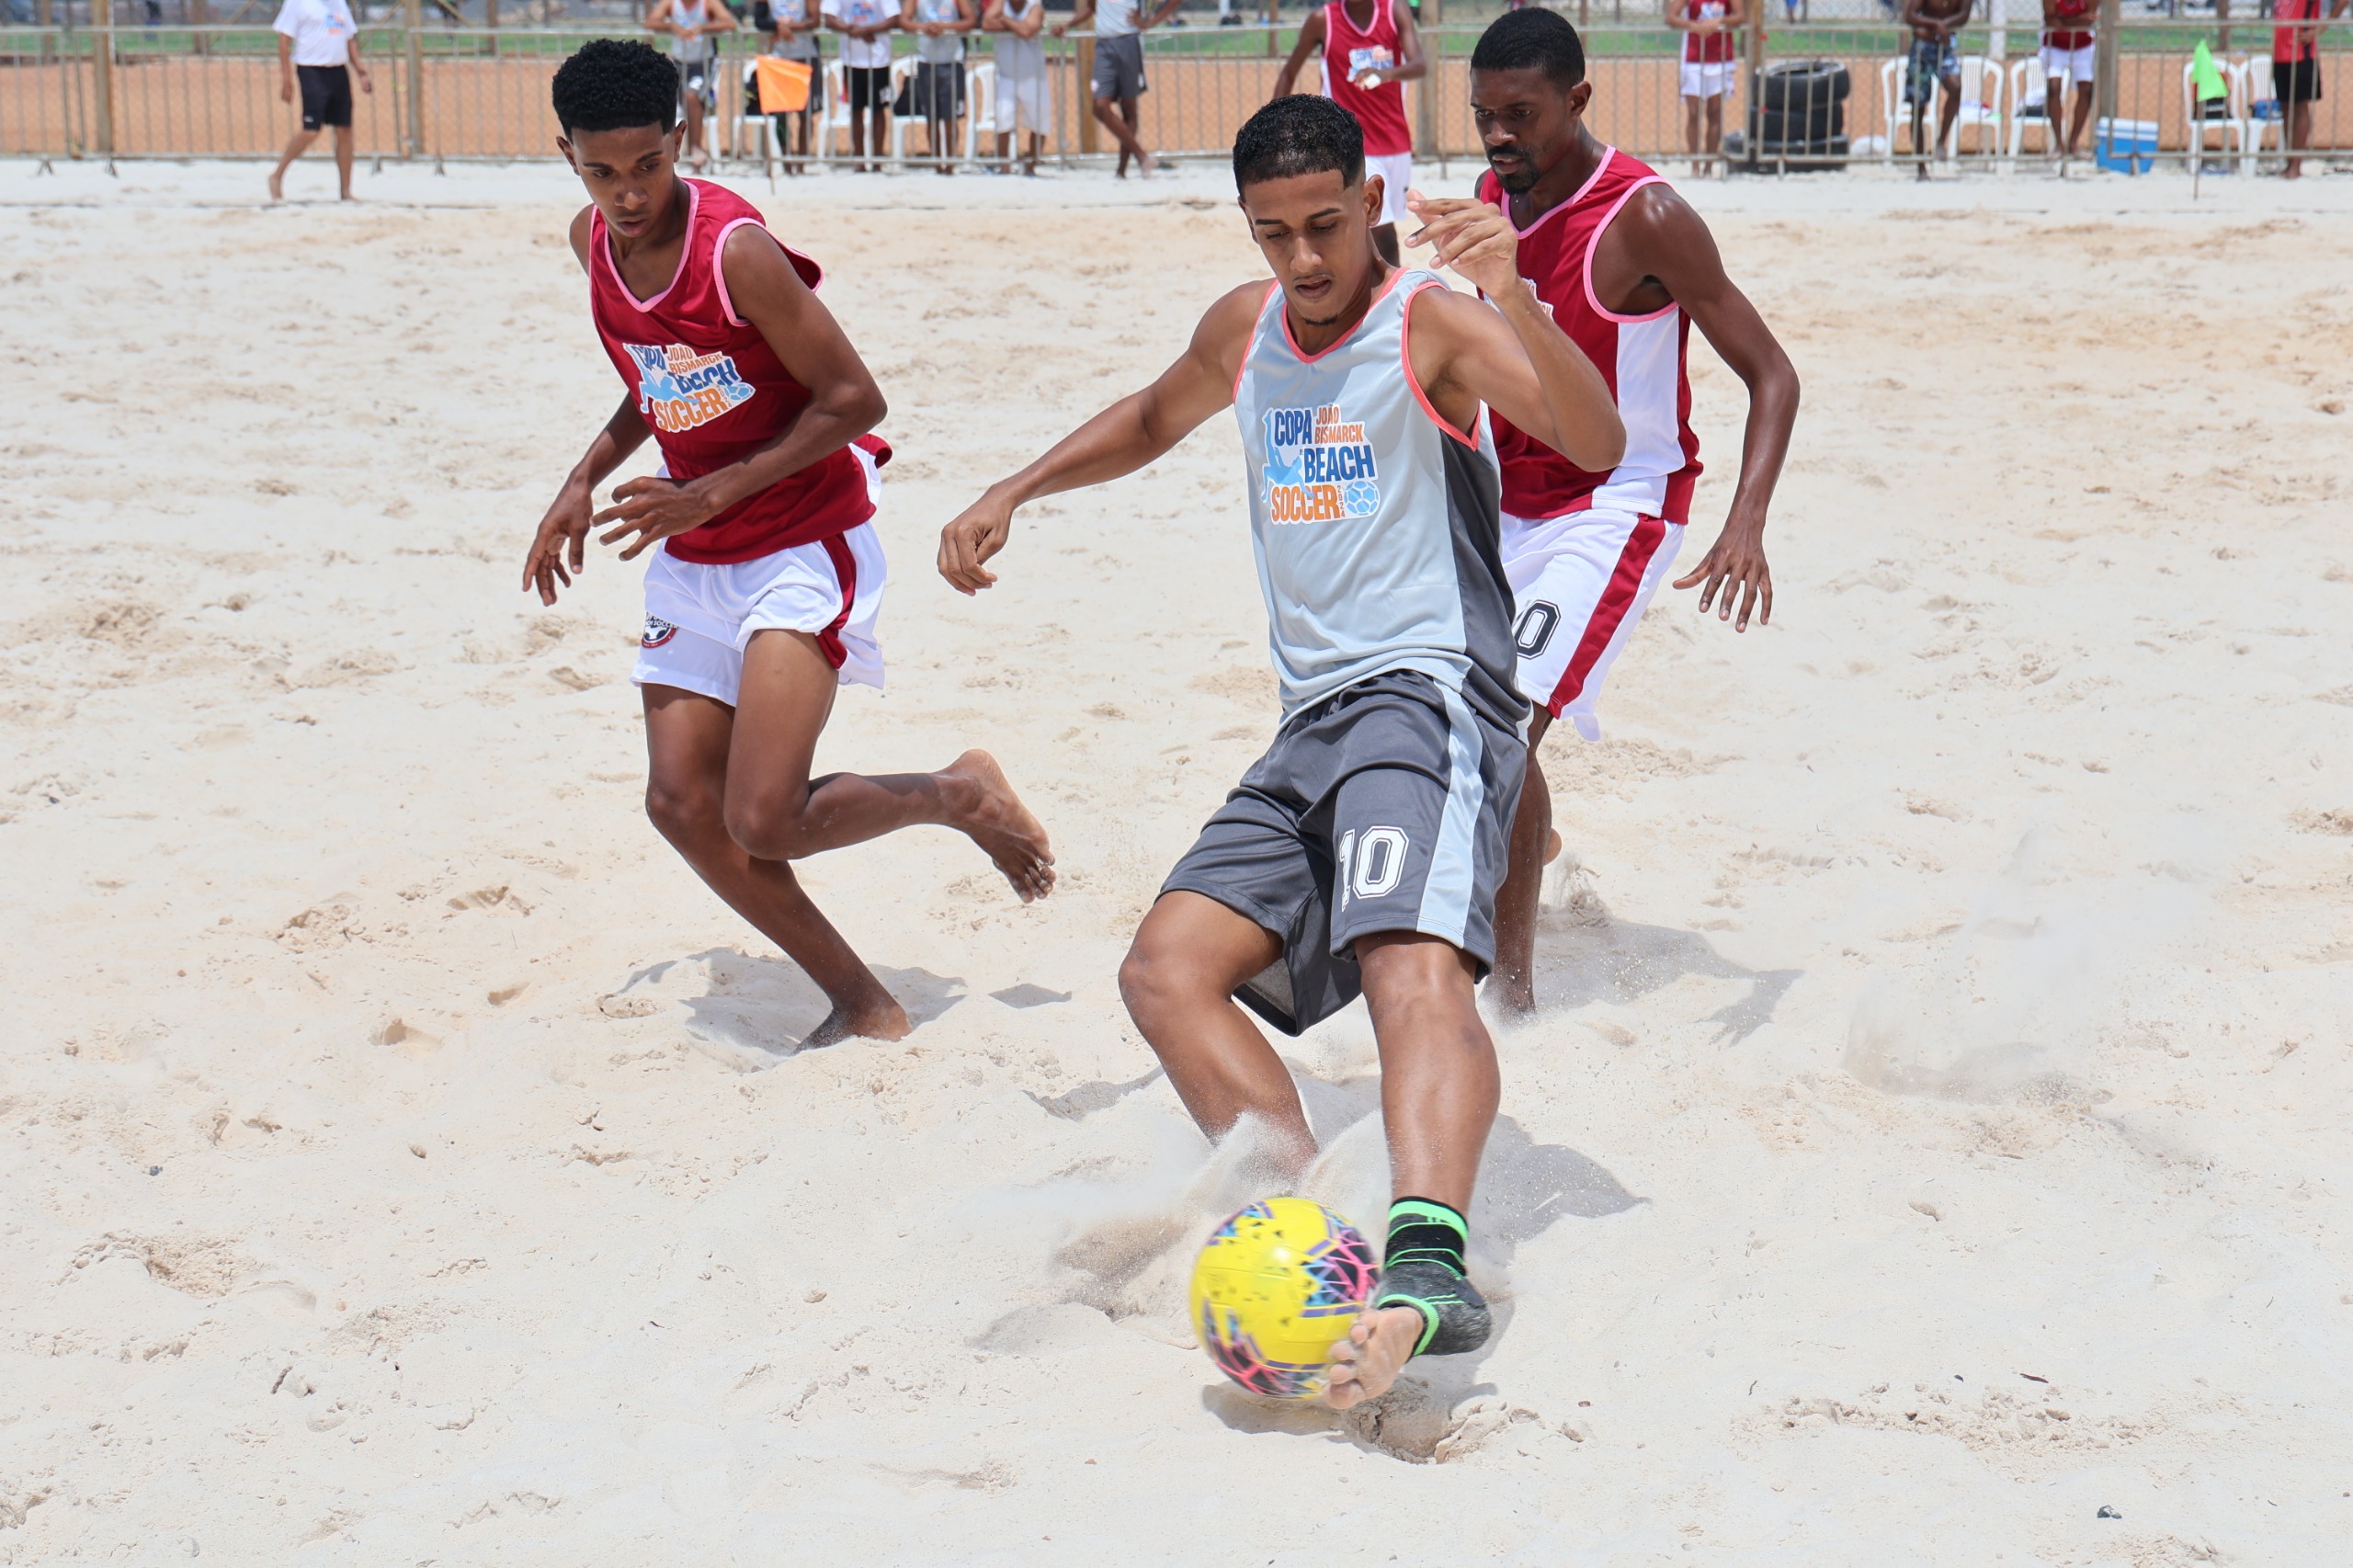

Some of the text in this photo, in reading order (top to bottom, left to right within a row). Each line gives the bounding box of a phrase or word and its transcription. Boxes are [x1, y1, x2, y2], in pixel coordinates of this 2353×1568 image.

[668, 353, 723, 375] BISMARCK
[654, 388, 729, 432] SOCCER
[1274, 410, 1313, 447] COPA
[1316, 404, 1339, 426] JOÃO
[1314, 424, 1364, 445] BISMARCK
[1303, 445, 1376, 483] BEACH
[1271, 484, 1342, 522] SOCCER
[1339, 825, 1410, 913] 10
